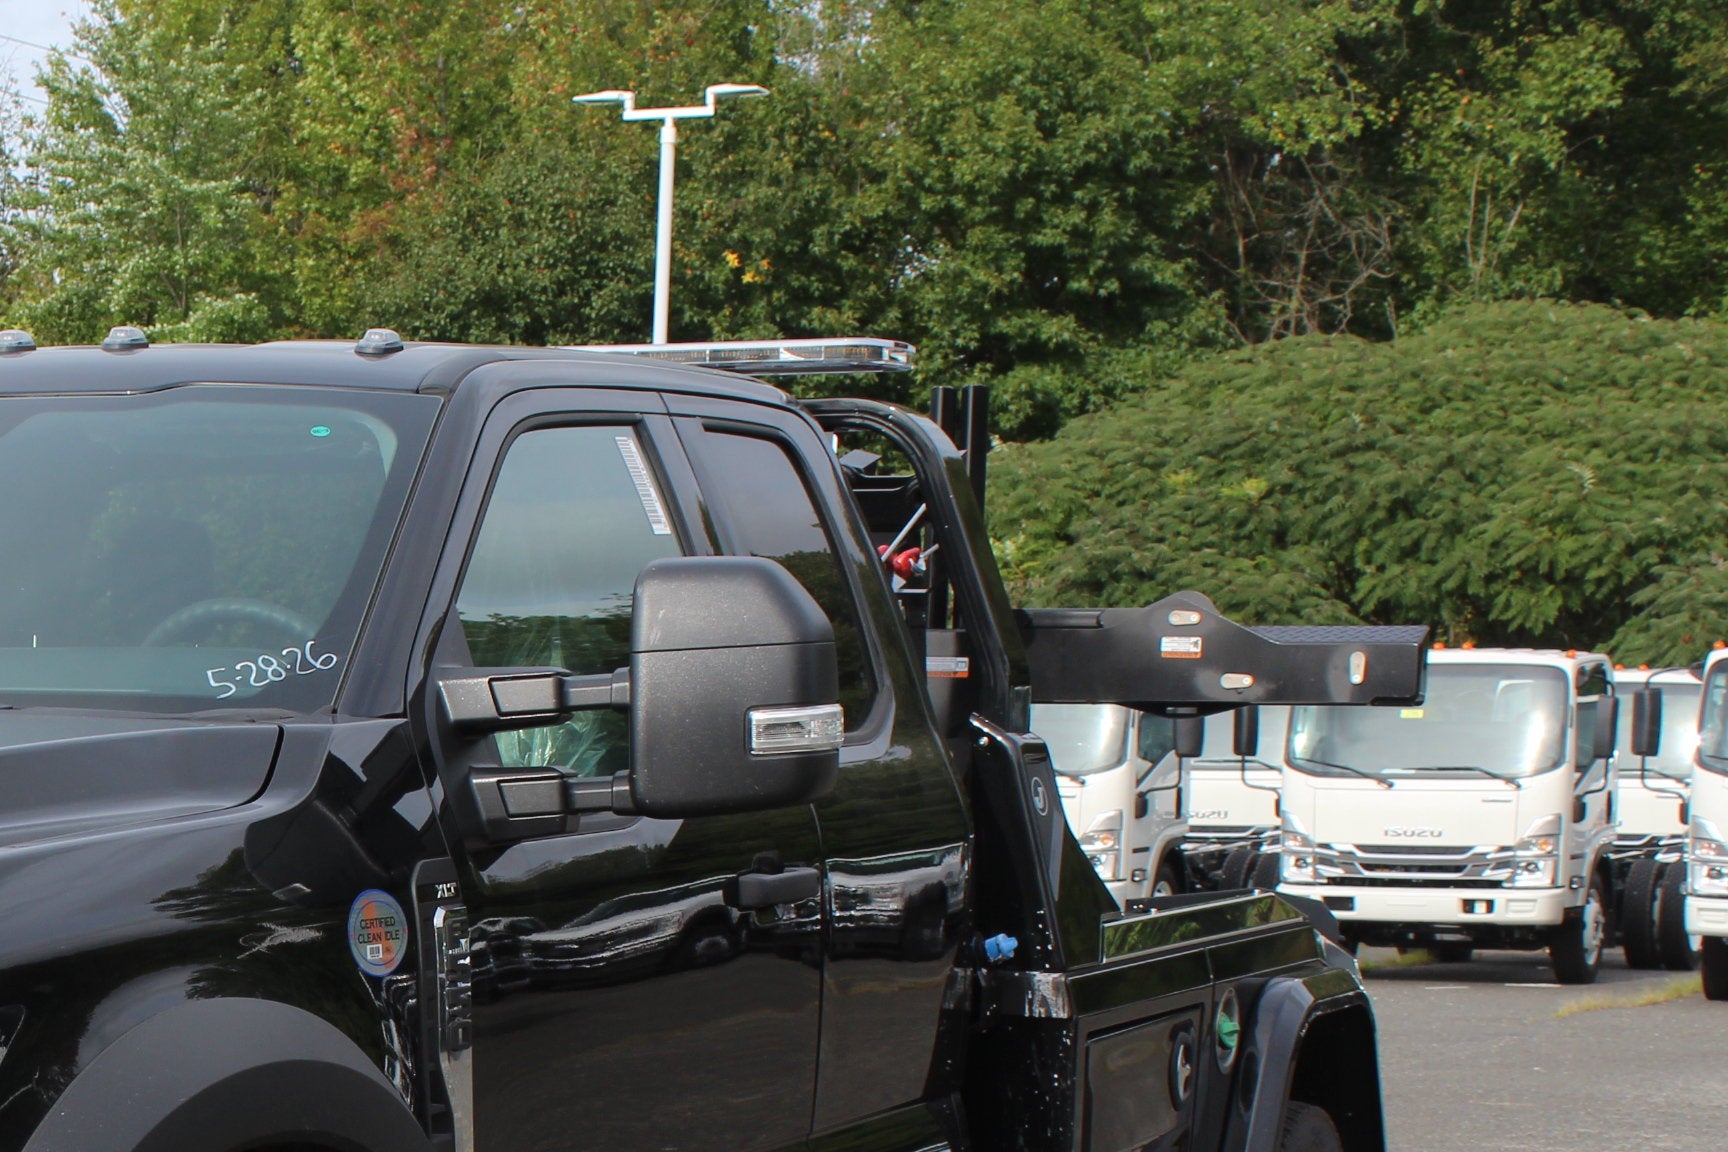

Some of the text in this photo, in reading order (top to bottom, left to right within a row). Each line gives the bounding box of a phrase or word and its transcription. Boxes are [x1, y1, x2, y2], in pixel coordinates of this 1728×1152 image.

[1185, 809, 1229, 820] SUZU
[1383, 826, 1443, 838] ISUZU
[435, 882, 457, 899] XLT
[359, 916, 396, 930] CERTIFIED
[357, 929, 400, 944] CLEAN IDLE
